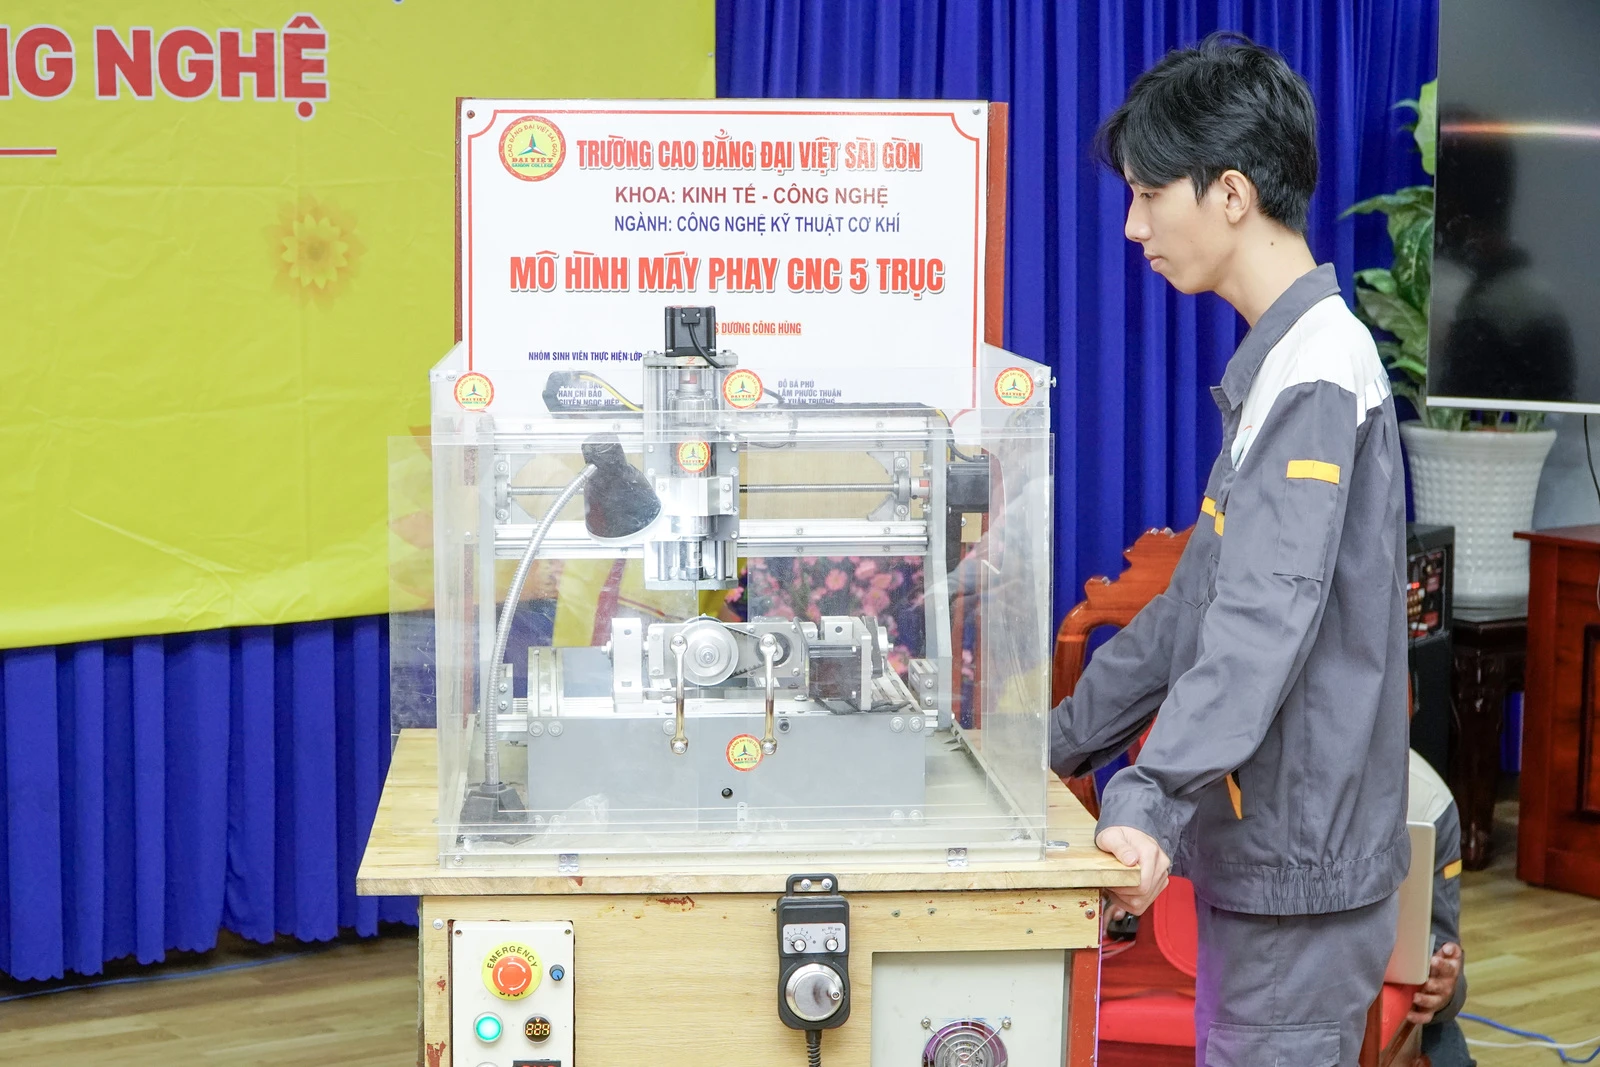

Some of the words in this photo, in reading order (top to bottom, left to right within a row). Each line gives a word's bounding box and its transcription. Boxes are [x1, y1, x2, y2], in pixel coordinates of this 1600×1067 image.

[0, 25, 75, 101] G
[95, 13, 329, 121] NGHỆ
[576, 134, 653, 169] TRƯỜNG
[657, 140, 698, 169] CAO
[702, 128, 755, 170] ĐẲNG
[760, 141, 794, 175] ĐẠI
[799, 136, 840, 175] VIỆT
[844, 136, 877, 171] SÀI
[882, 136, 922, 171] GÒN
[615, 186, 675, 203] KHOA:
[682, 186, 727, 204] KINH
[732, 183, 756, 204] TẾ
[773, 183, 829, 204] CÔNG
[835, 184, 889, 208] NGHỆ
[614, 211, 672, 232] NGÀNH:
[677, 211, 720, 232] CÔNG
[725, 213, 767, 236] NGHỆ
[770, 212, 791, 232] KỸ
[795, 213, 844, 236] THUẬT
[848, 216, 872, 233] CƠ
[875, 212, 901, 233] KHÍ
[510, 250, 558, 292] MÔ
[564, 250, 629, 292] HÌNH
[638, 250, 701, 293] MÁY
[708, 257, 780, 293] PHAY
[787, 257, 842, 293] CNC
[849, 258, 869, 294] 5
[876, 258, 946, 300] TRỤC
[721, 321, 751, 335] DƯƠNG
[752, 320, 776, 335] CÔNG
[778, 320, 802, 335] HÙNG
[528, 350, 551, 361] NHÓM
[552, 351, 570, 361] SINH
[572, 350, 588, 361] VIÊN
[590, 350, 609, 363] THỰC
[630, 351, 643, 361] LỚP
[486, 945, 538, 969] EMERGENCY
